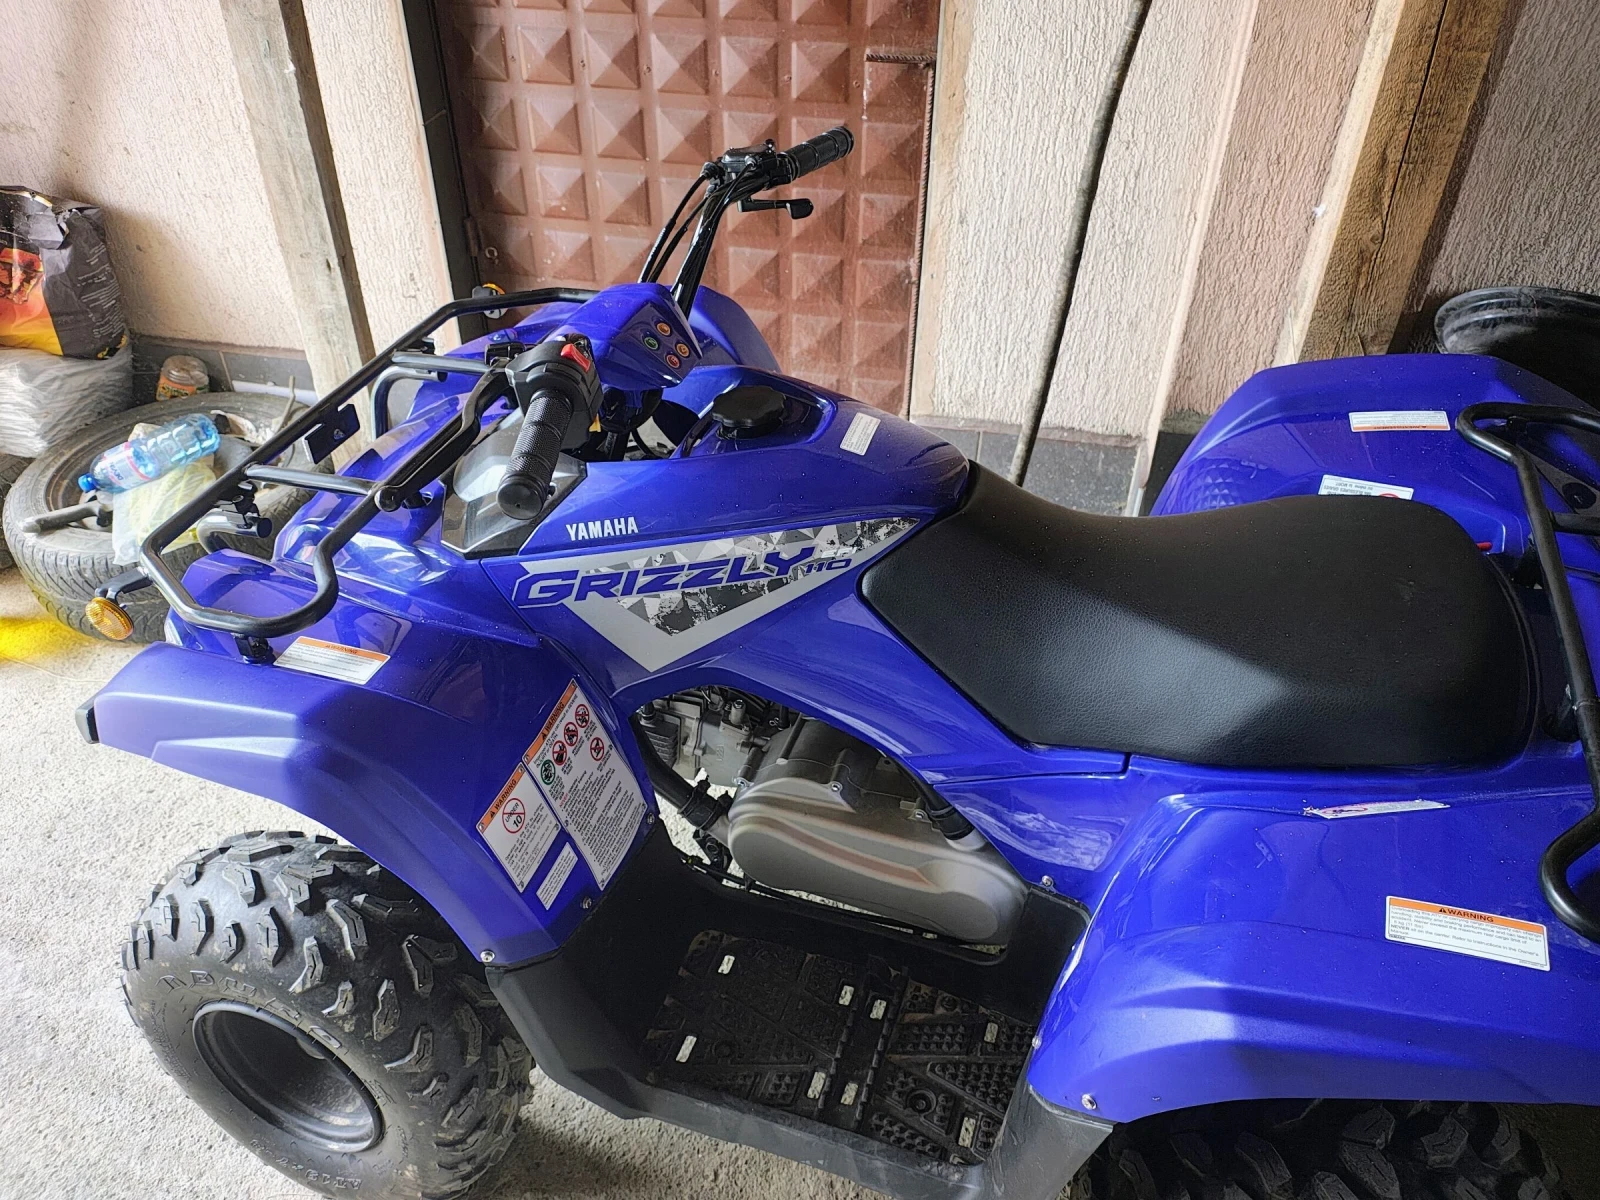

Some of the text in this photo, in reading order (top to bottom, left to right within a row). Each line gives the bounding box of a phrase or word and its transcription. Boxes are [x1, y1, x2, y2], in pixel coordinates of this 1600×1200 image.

[566, 516, 639, 541] YAMAHA
[512, 544, 852, 608] GRIZZLY 110
[544, 701, 565, 731] WARNING
[495, 778, 517, 811] WARNING
[505, 802, 519, 823] UNDER
[512, 814, 523, 828] 10
[1448, 909, 1494, 922] WARNING
